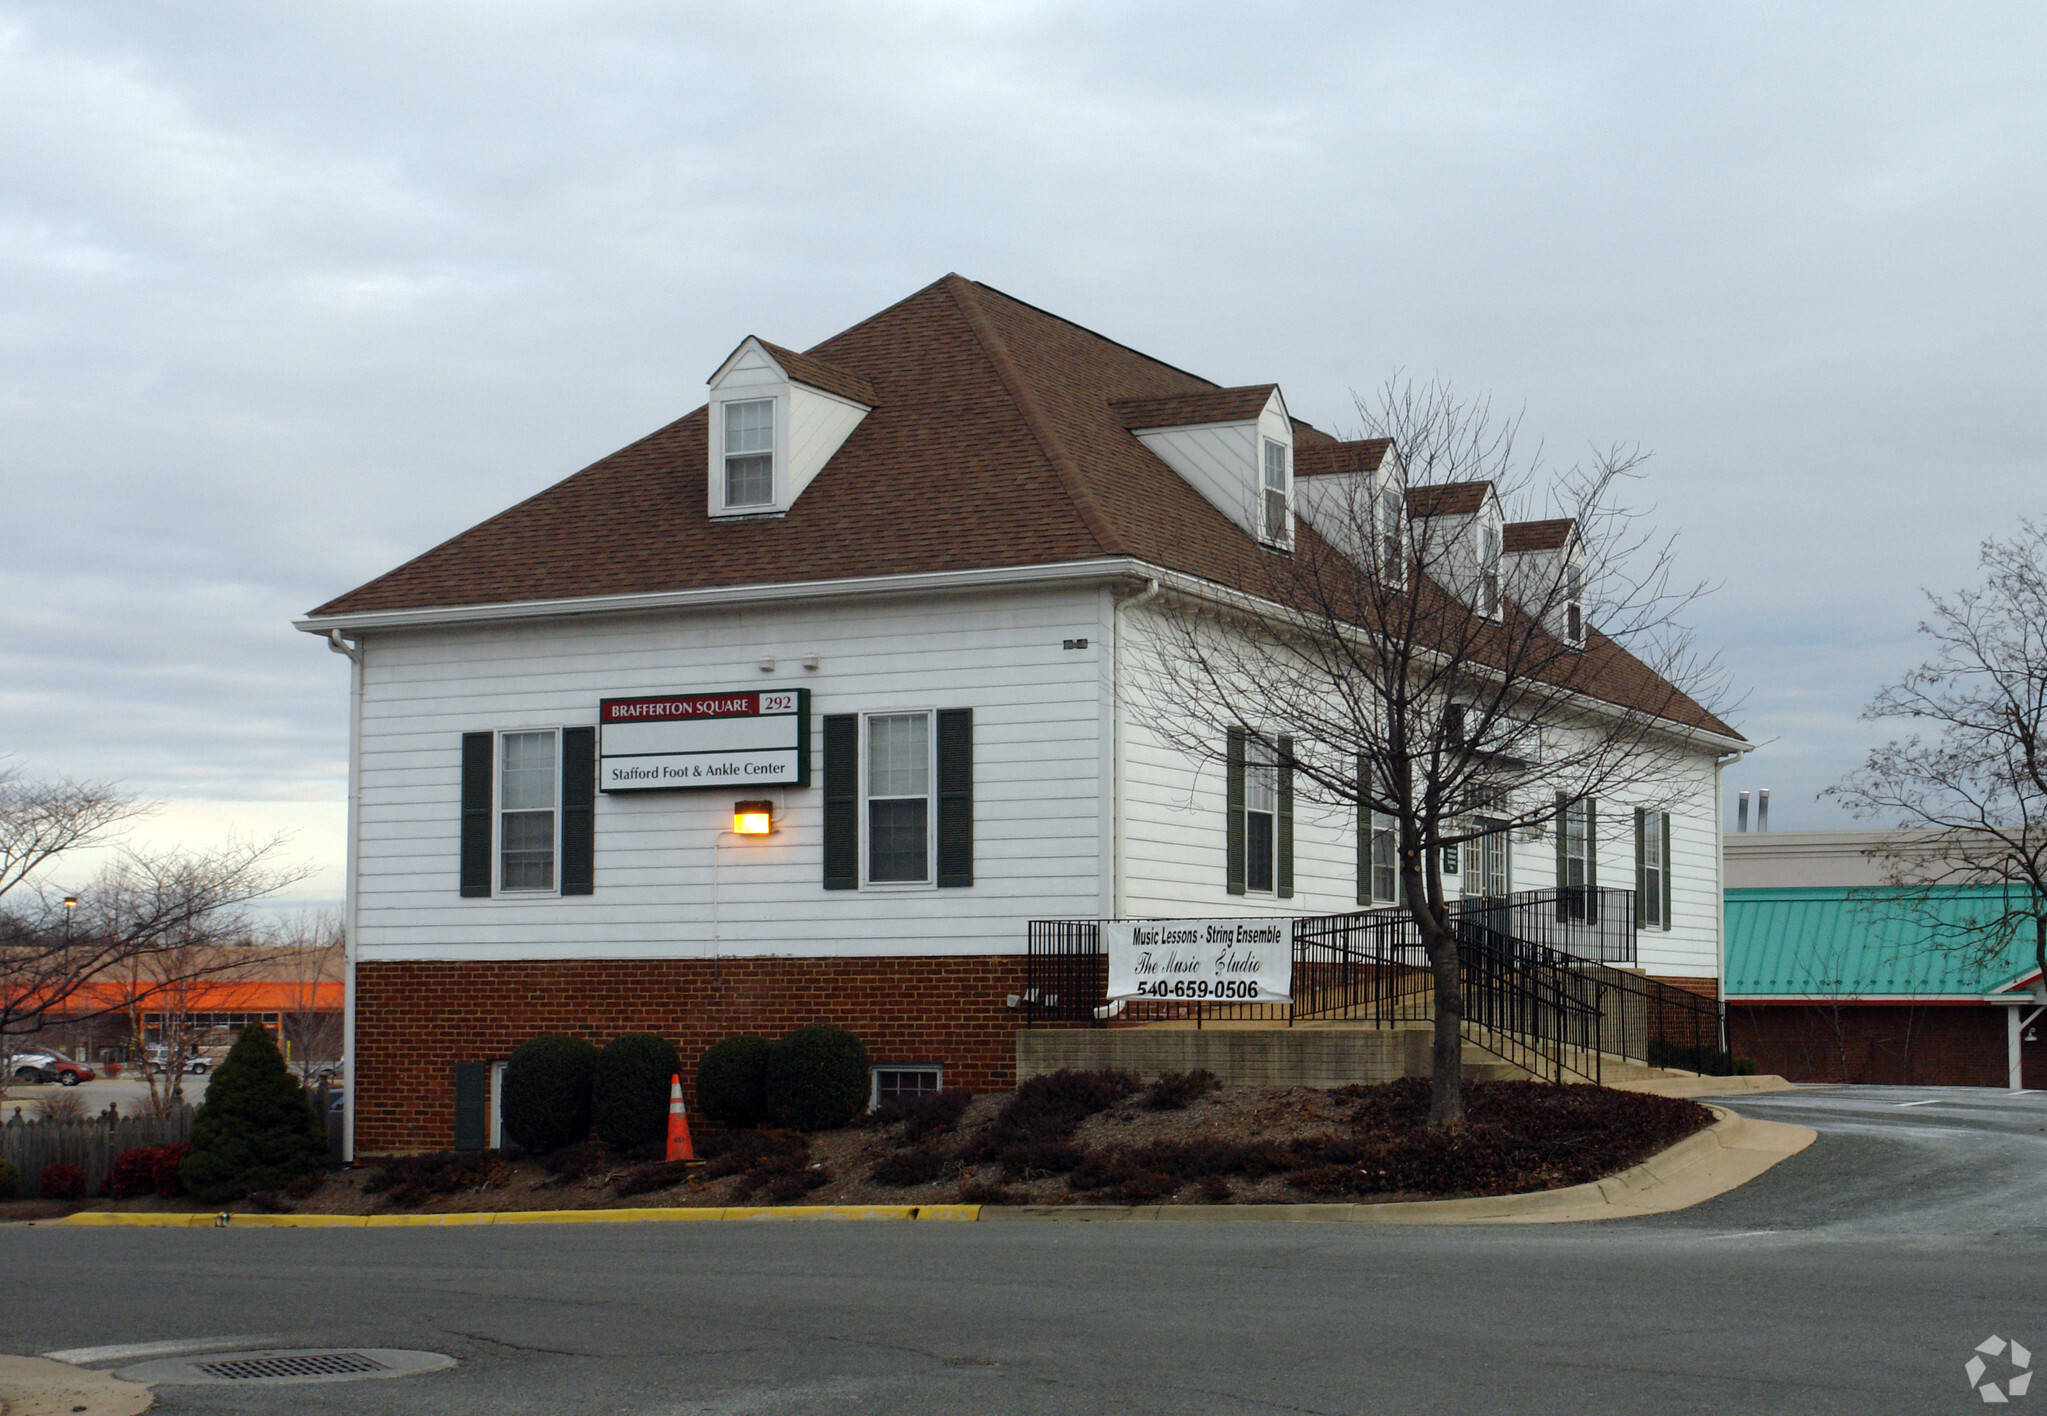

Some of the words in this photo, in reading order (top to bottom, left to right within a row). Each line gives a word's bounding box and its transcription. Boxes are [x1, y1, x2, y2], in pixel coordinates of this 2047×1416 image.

[612, 702, 693, 717] BRAFFERTON
[696, 699, 749, 715] SQUARE
[765, 696, 791, 710] 292
[612, 766, 659, 780] Stafford
[663, 766, 689, 778] Foot
[692, 765, 702, 777] &
[706, 763, 740, 776] Ankle
[744, 762, 786, 775] Center
[1133, 927, 1159, 946] Music
[1161, 926, 1198, 944] Lessons
[1206, 925, 1234, 948] String
[1236, 925, 1281, 944] Ensemble
[1134, 951, 1160, 975] The
[1161, 951, 1200, 973] Music
[1137, 980, 1258, 998] 540-659-0506
